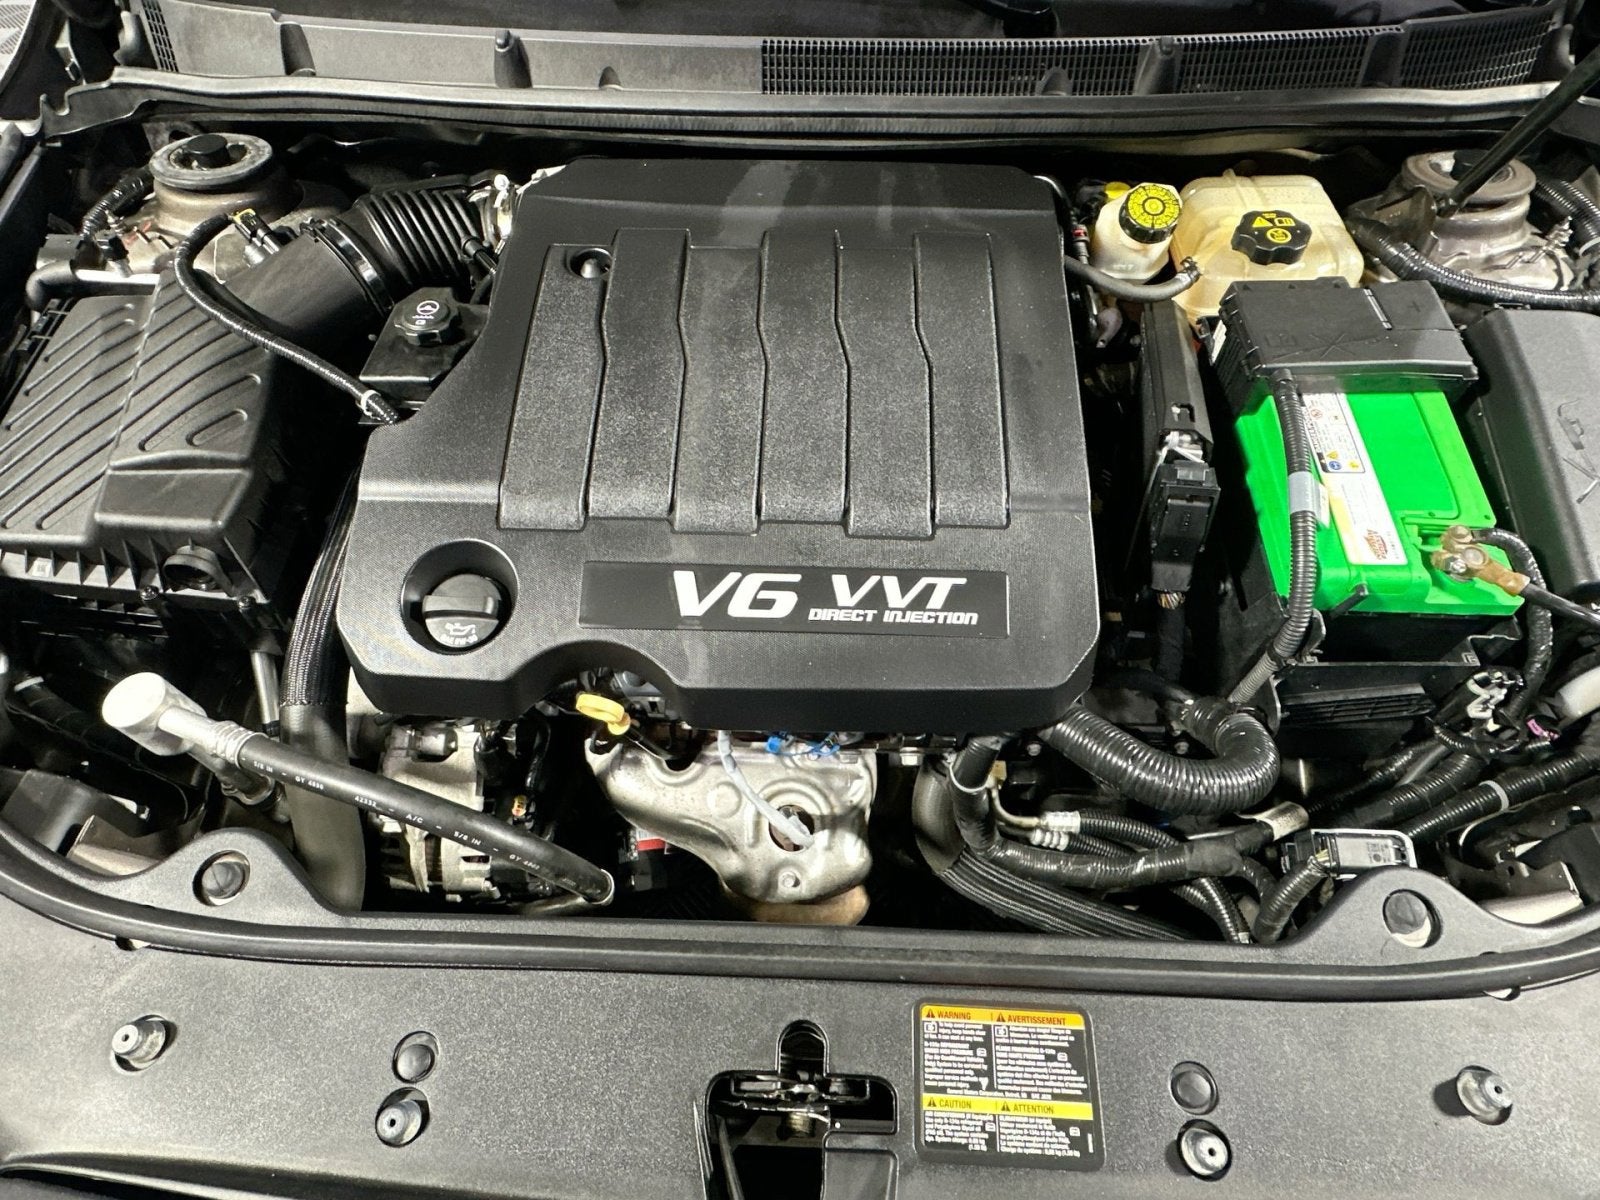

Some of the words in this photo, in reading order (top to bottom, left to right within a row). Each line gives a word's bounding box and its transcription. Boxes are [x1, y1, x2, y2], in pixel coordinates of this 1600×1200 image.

[673, 570, 802, 618] V6
[831, 574, 968, 609] VVT
[808, 608, 877, 623] DIRECT
[883, 610, 978, 625] INJECTION
[406, 813, 423, 824] A/C
[453, 831, 468, 841] 5/8
[471, 838, 482, 846] IN
[937, 1010, 971, 1020] WARNING
[1007, 1014, 1066, 1026] AVERTISSEMENT
[939, 1099, 972, 1109] CAUTION
[1013, 1103, 1054, 1114] ATTENTION
